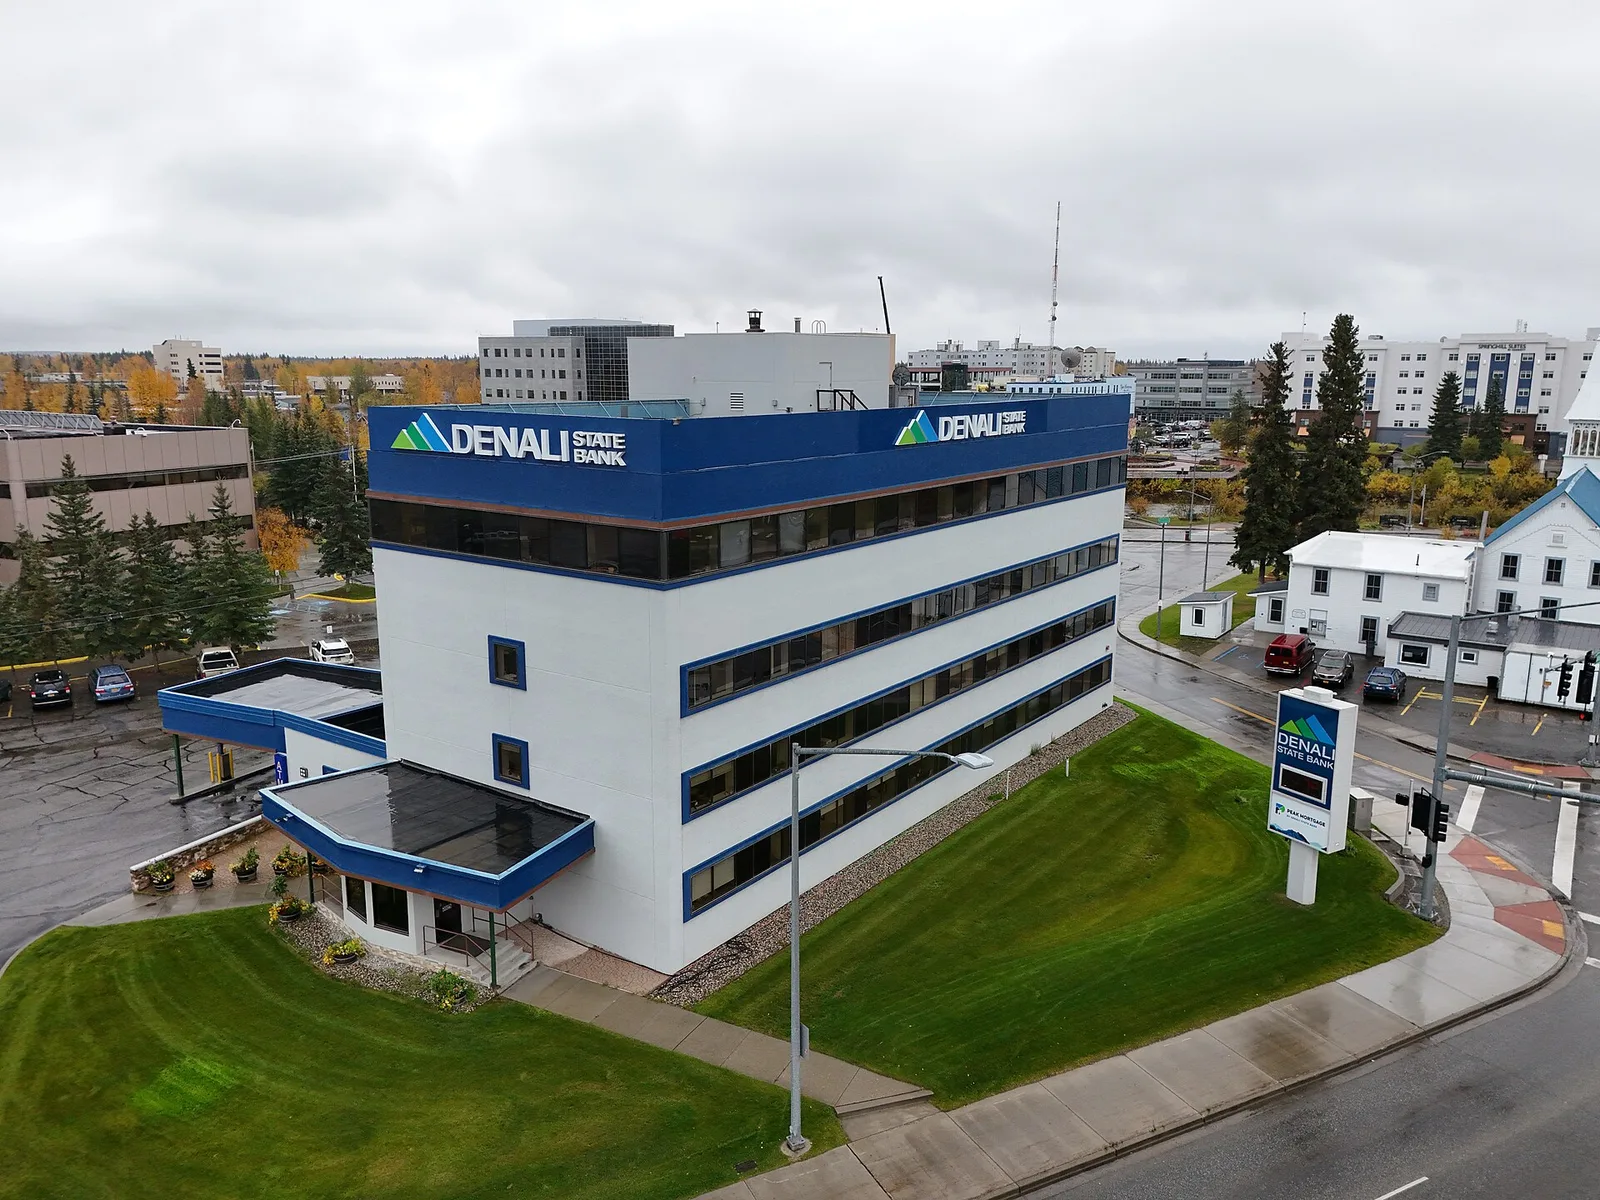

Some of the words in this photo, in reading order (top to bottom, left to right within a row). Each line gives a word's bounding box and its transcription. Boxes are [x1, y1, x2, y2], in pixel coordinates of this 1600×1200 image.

[1002, 410, 1026, 423] STATE
[938, 412, 1002, 441] DENALI
[1002, 422, 1026, 434] BANK
[451, 423, 570, 462] DENALI
[572, 431, 626, 449] STATE
[573, 448, 627, 466] BANK
[1278, 731, 1336, 761] DENALI
[1277, 745, 1304, 761] STATE
[1306, 754, 1334, 770] BANK
[1286, 808, 1299, 817] PEAK
[1300, 814, 1326, 827] MORTGAGE
